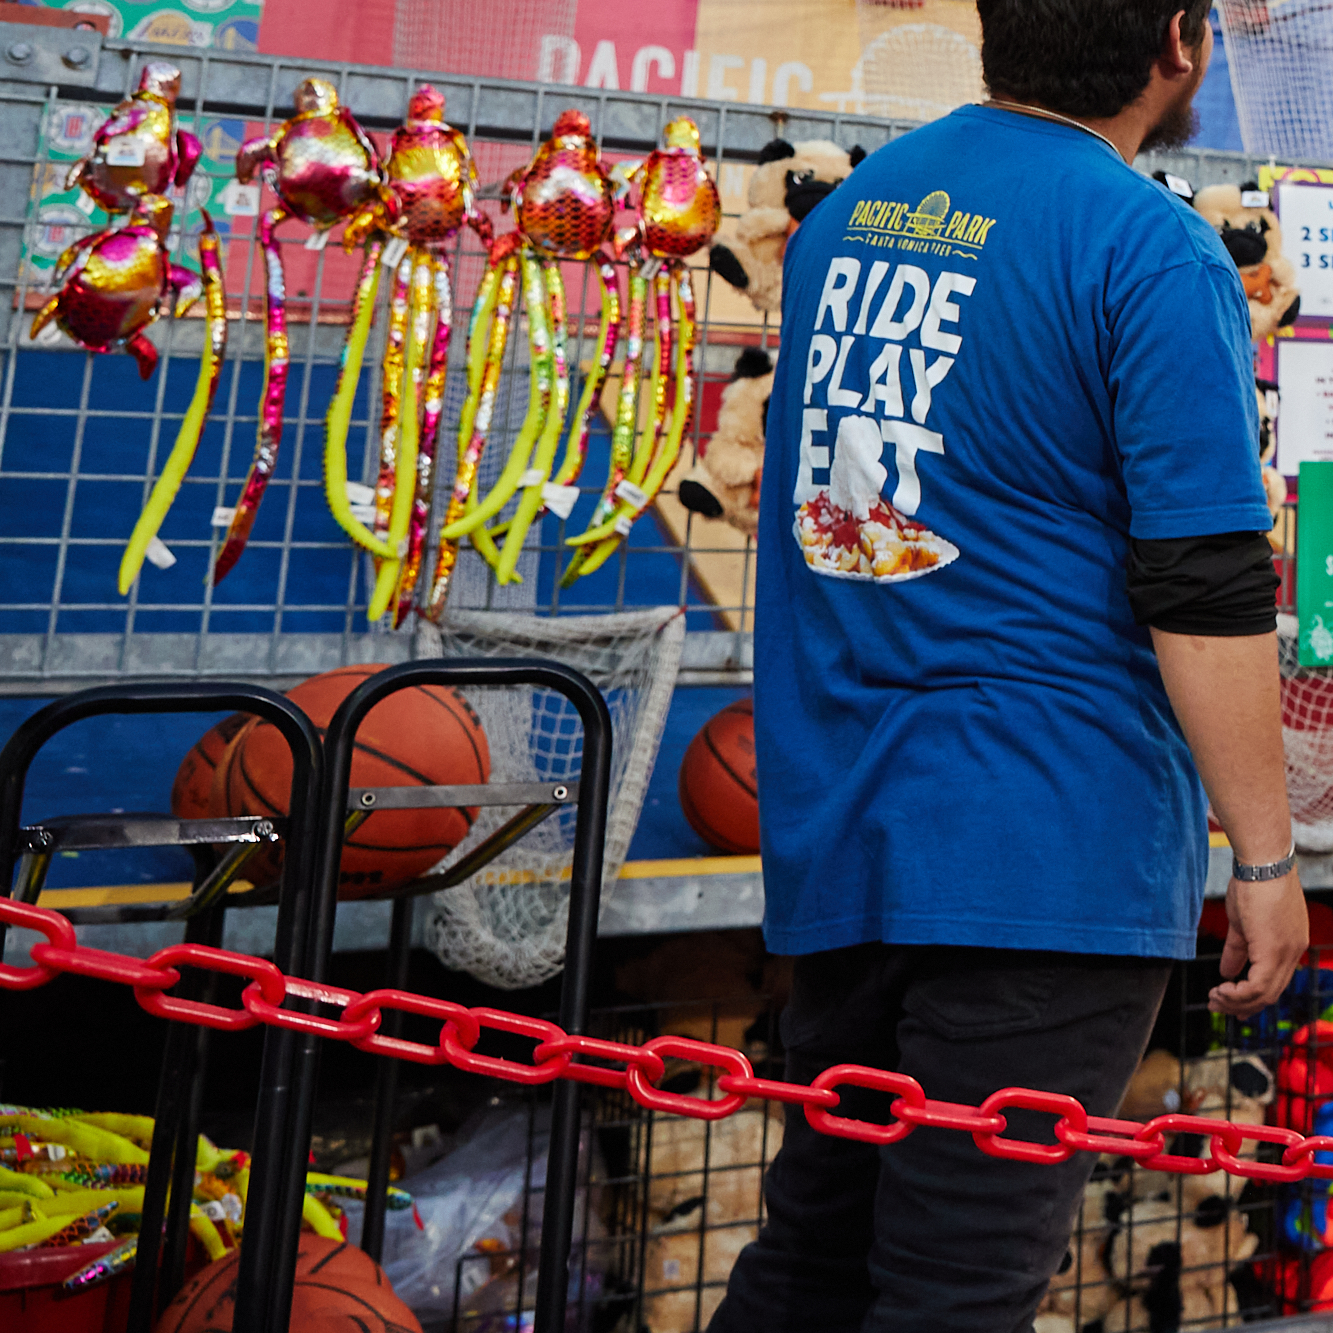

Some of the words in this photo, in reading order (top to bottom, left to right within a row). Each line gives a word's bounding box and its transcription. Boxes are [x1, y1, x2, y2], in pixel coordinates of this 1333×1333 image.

[849, 200, 909, 230] PACIFIC
[945, 211, 997, 245] PARK
[1301, 227, 1311, 241] 2
[1301, 254, 1311, 268] 3
[814, 256, 977, 354] RIDE
[803, 334, 956, 425] PLAY
